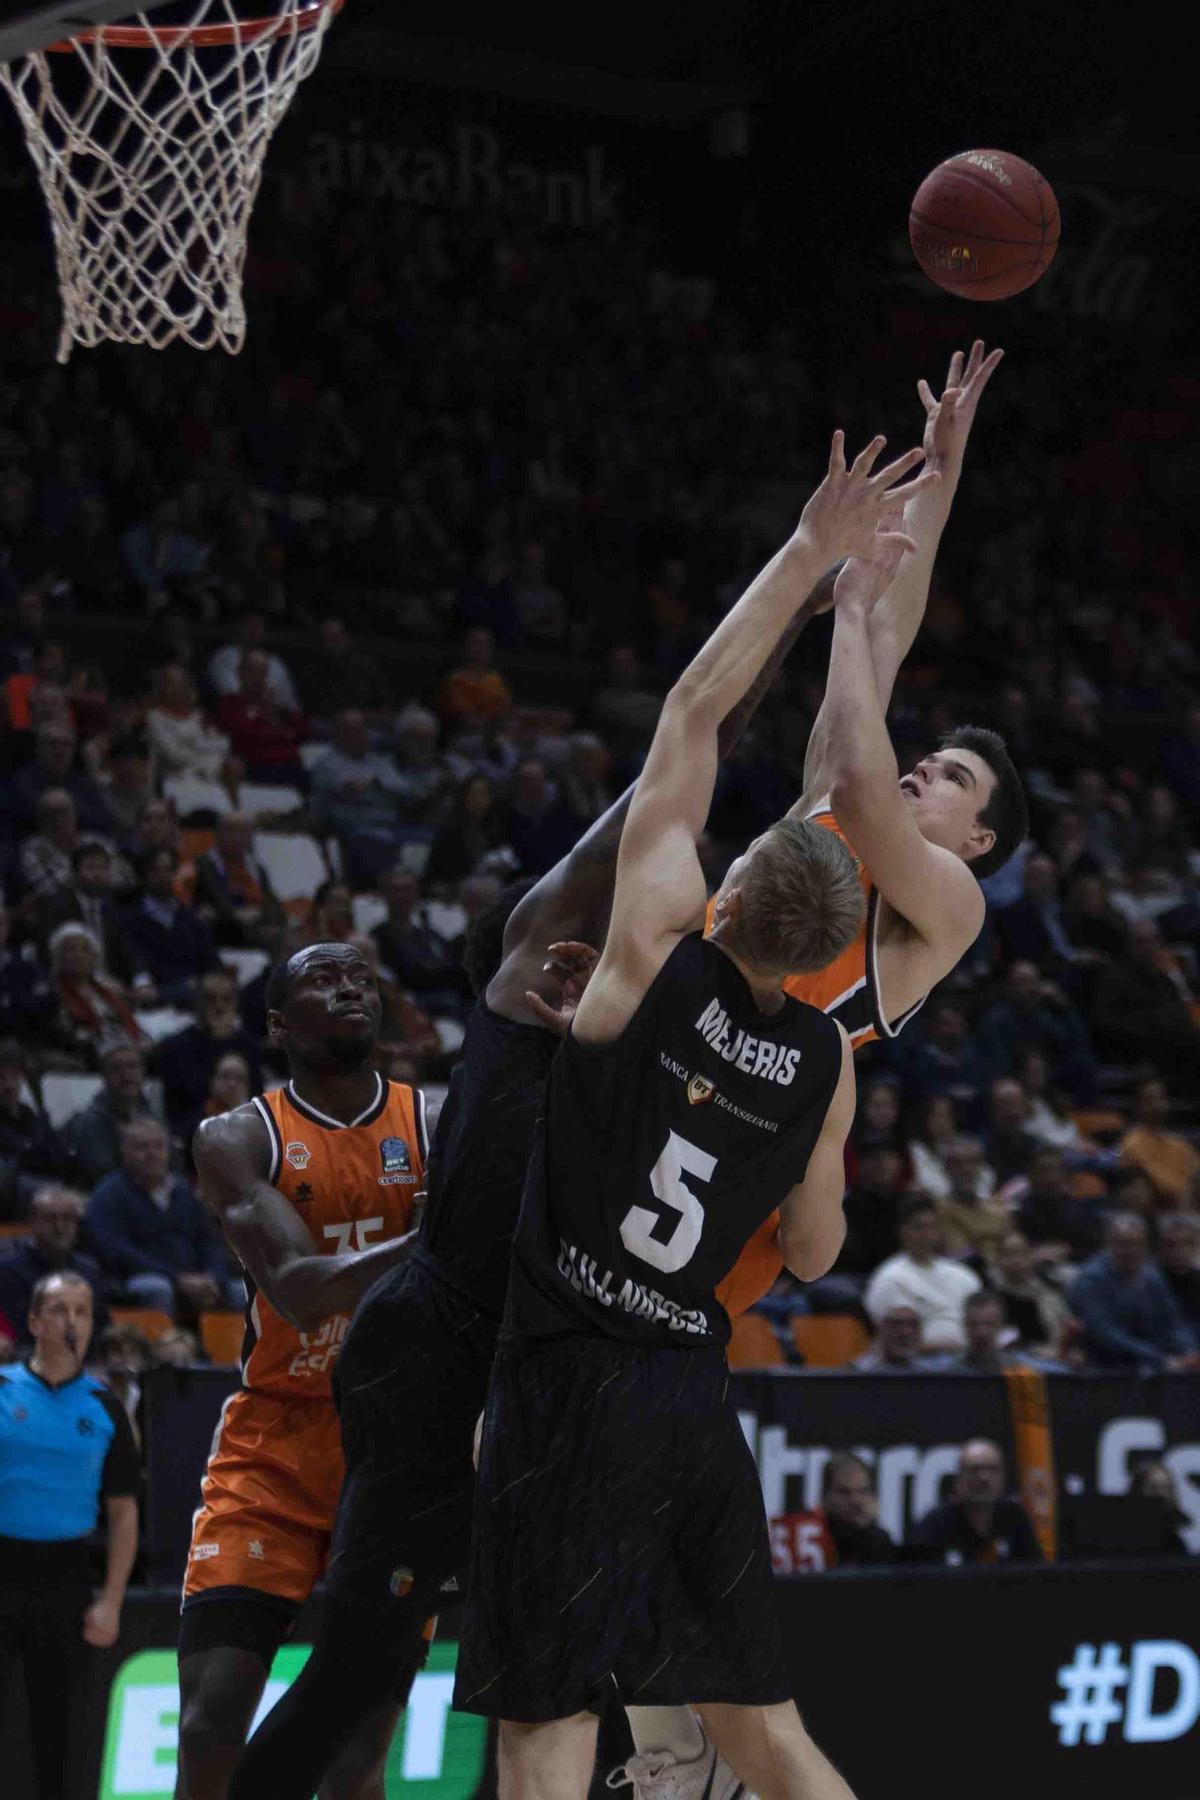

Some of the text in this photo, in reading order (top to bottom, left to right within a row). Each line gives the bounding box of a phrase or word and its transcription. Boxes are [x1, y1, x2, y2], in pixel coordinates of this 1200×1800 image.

[694, 997, 801, 1086] MEJERIS
[619, 1128, 718, 1274] 5
[1050, 1640, 1200, 1747] #D
